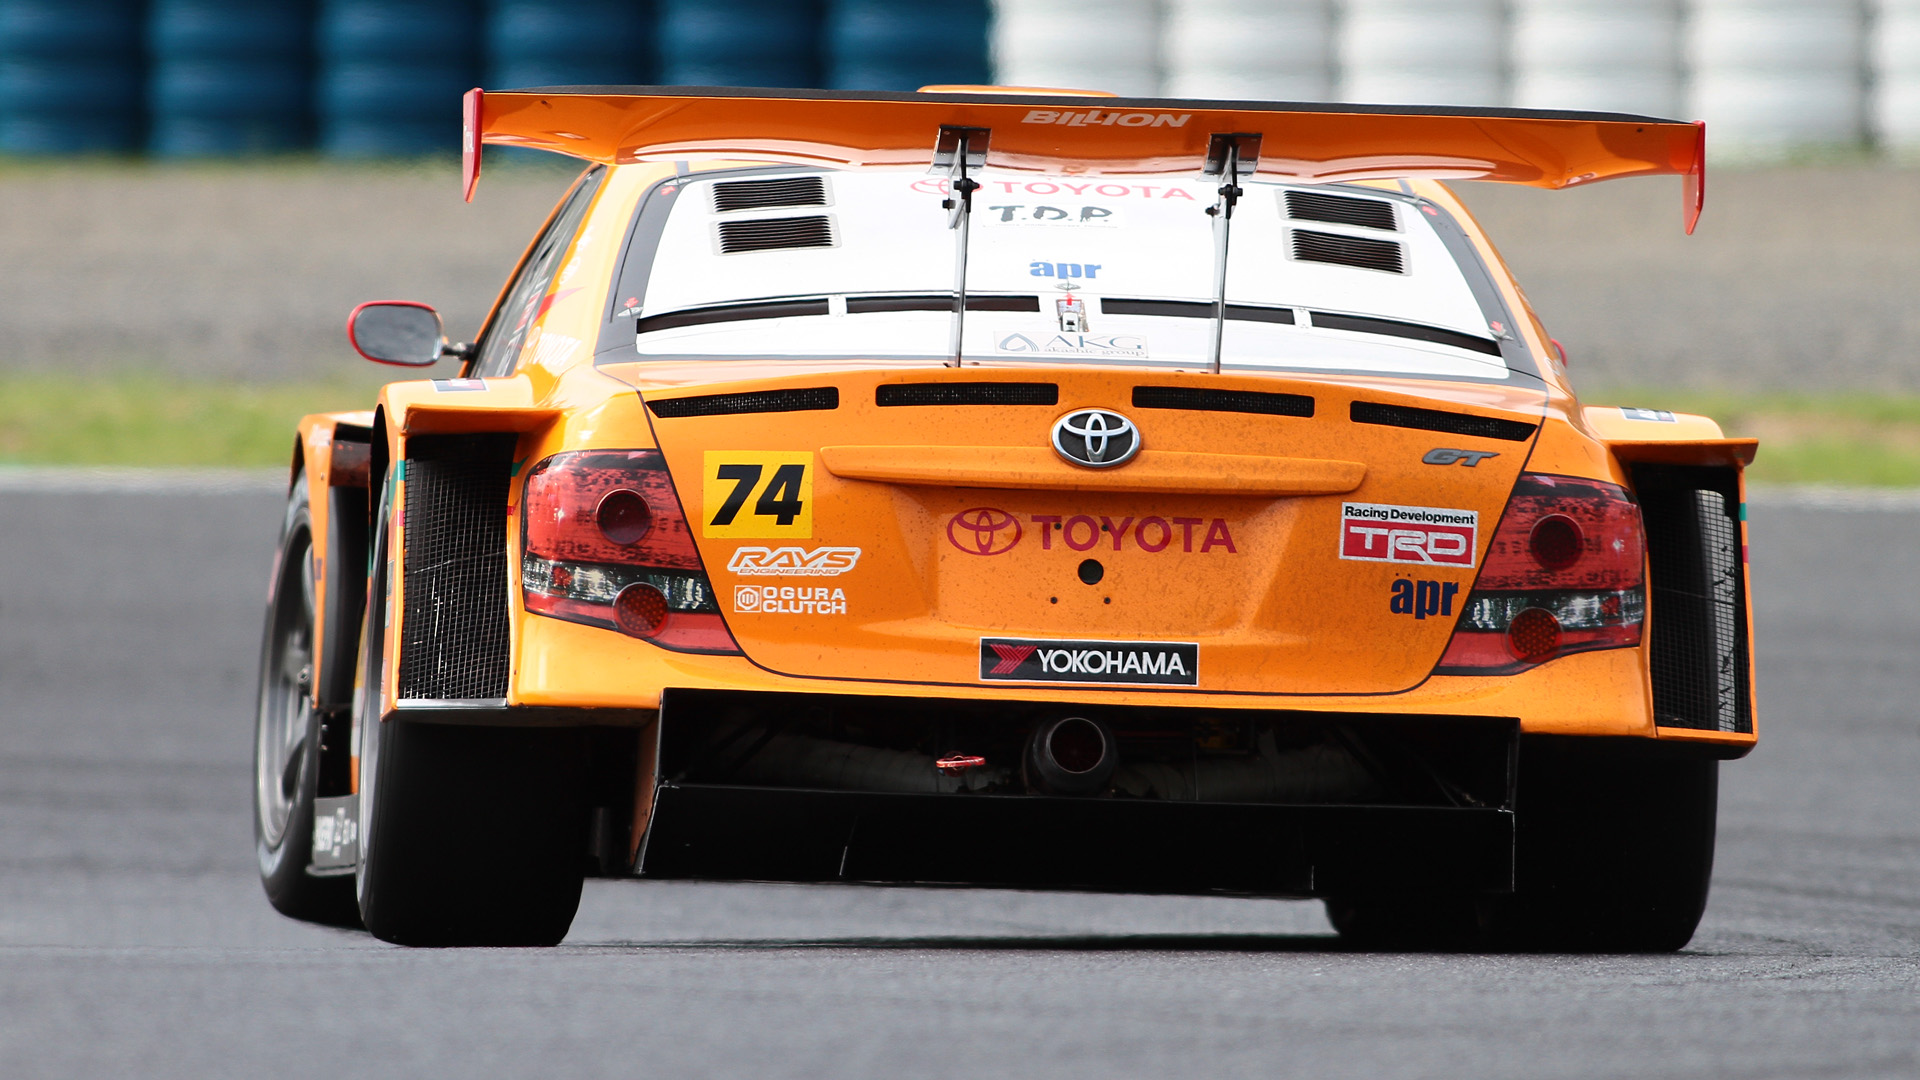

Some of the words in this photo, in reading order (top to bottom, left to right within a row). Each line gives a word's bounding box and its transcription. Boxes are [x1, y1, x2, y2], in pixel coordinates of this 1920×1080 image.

[1021, 109, 1192, 128] BILLION
[993, 180, 1196, 201] TOYOTA
[1029, 260, 1102, 279] apr
[1044, 334, 1142, 349] AKG
[1043, 346, 1096, 355] akashic
[1101, 348, 1145, 357] group
[1422, 448, 1500, 467] GT
[709, 464, 804, 526] 74
[1344, 506, 1389, 521] Racing
[1390, 508, 1475, 525] Development
[1031, 514, 1237, 554] TOYOTA
[1349, 526, 1467, 562] TRD
[729, 548, 860, 570] RAYS
[738, 568, 842, 576] ENGINEERING
[762, 586, 846, 601] OGURA
[1390, 578, 1458, 620] apr
[762, 600, 847, 615] CLUTCH
[1037, 647, 1186, 677] YOKOHAMA
